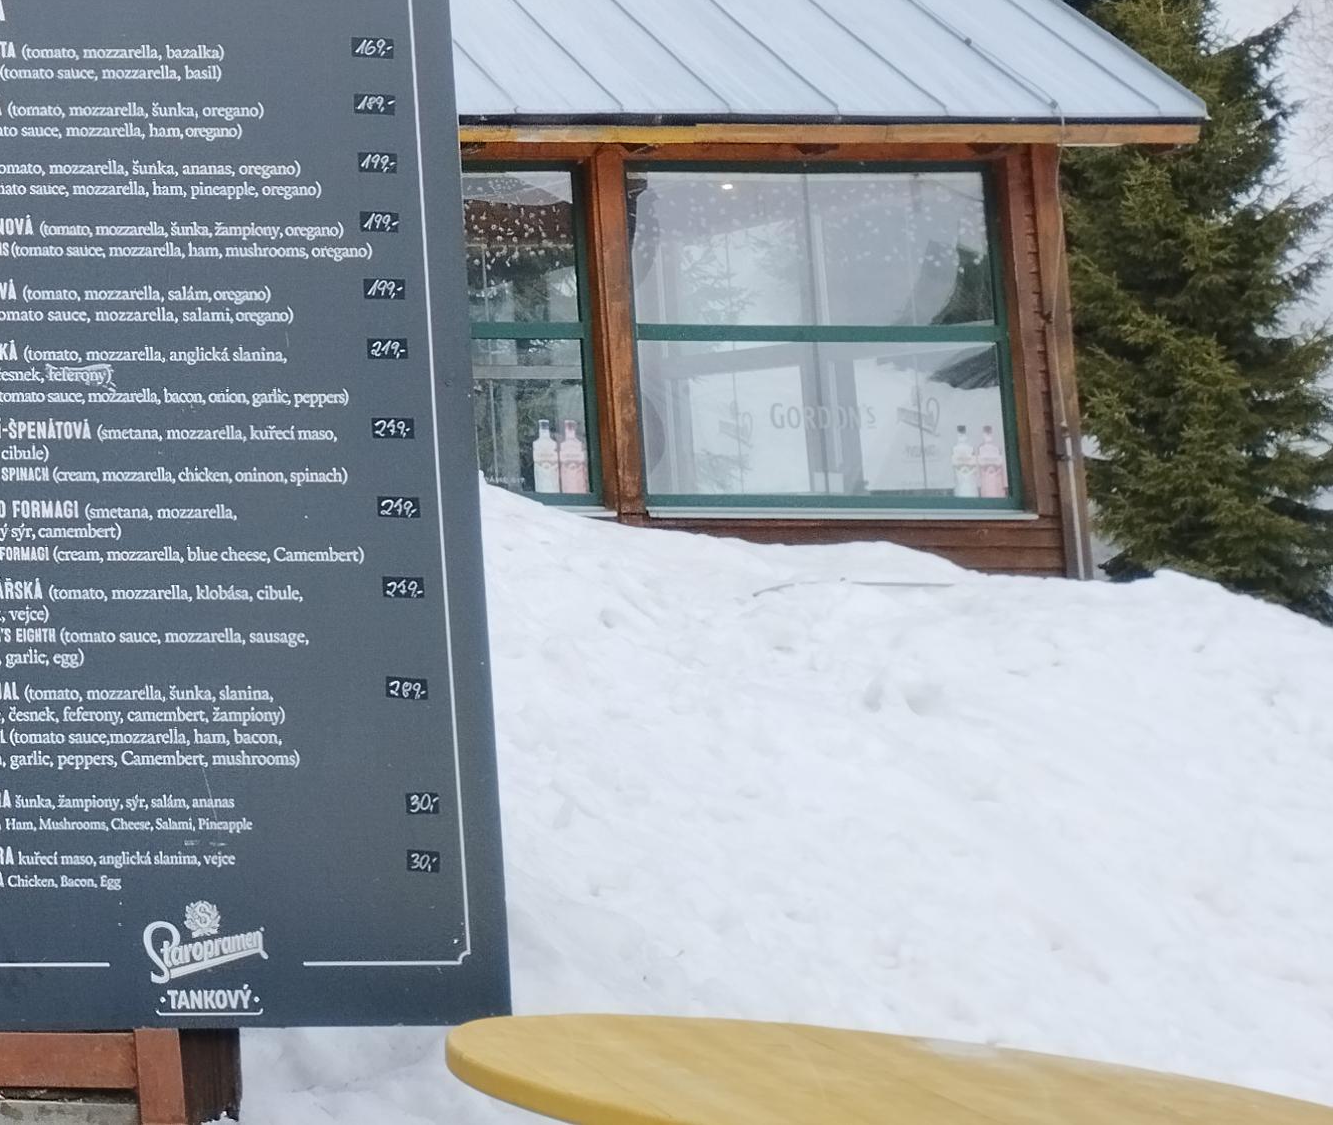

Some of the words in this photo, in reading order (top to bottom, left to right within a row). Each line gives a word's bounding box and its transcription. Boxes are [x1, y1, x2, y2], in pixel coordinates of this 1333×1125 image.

[21, 43, 79, 60] (tomato,
[83, 44, 161, 60] mozzarella,
[165, 44, 224, 61] bazalka)
[355, 38, 393, 56] 169,-
[7, 101, 65, 118] (tomato,
[69, 101, 148, 118] mozzarella,
[202, 101, 263, 120] oregano)
[49, 158, 128, 176] mozzarella,
[182, 164, 235, 176] ananas,
[238, 159, 300, 179] oregano)
[39, 220, 92, 237] (tomato,
[95, 220, 168, 238] mozzarella,
[284, 221, 343, 240] oregano)
[22, 284, 80, 302] (tomato,
[84, 284, 164, 302] mozzarella,
[213, 285, 271, 304] oregano)
[367, 280, 403, 299] 199,-
[23, 344, 81, 363] (tomato,
[85, 346, 167, 362] mozzarella,
[232, 346, 287, 363] slanina,
[97, 424, 162, 441] (smetana,
[165, 424, 246, 442] mozzarella,
[297, 429, 337, 442] maso,
[1, 444, 49, 462] cibule)
[12, 501, 78, 518] FORMAGI
[84, 503, 152, 520] (smetana,
[157, 503, 237, 520] mozzarella,
[38, 522, 121, 540] camembert)
[48, 584, 107, 601] (tomato,
[111, 584, 192, 602] mozzarella,
[256, 584, 303, 602] cibule,
[9, 604, 49, 625] vejce)
[59, 627, 115, 645] (tomato
[119, 631, 161, 644] sauce,
[164, 627, 245, 645] mozzarella,
[249, 632, 309, 647] sausage,
[5, 648, 49, 668] garlic,
[53, 647, 84, 668] egg)
[24, 684, 82, 703] (tomato,
[86, 683, 167, 702] mozzarella,
[219, 684, 273, 702] slanina,
[63, 705, 123, 725] feferony,
[127, 706, 208, 723] camembert,
[9, 728, 65, 746] (tomato
[193, 728, 229, 745] ham,
[233, 728, 281, 745] bacon,
[9, 750, 53, 769] garlic,
[57, 754, 117, 769] peppers,
[121, 750, 208, 767] Camembert,
[212, 749, 299, 768] mushrooms)
[191, 797, 234, 808] ananas
[60, 855, 96, 866] maso,
[153, 850, 201, 866] slanina,
[203, 851, 235, 867] vejce
[143, 921, 269, 983] Staropramen
[167, 984, 252, 1009] TANKOVÝ
